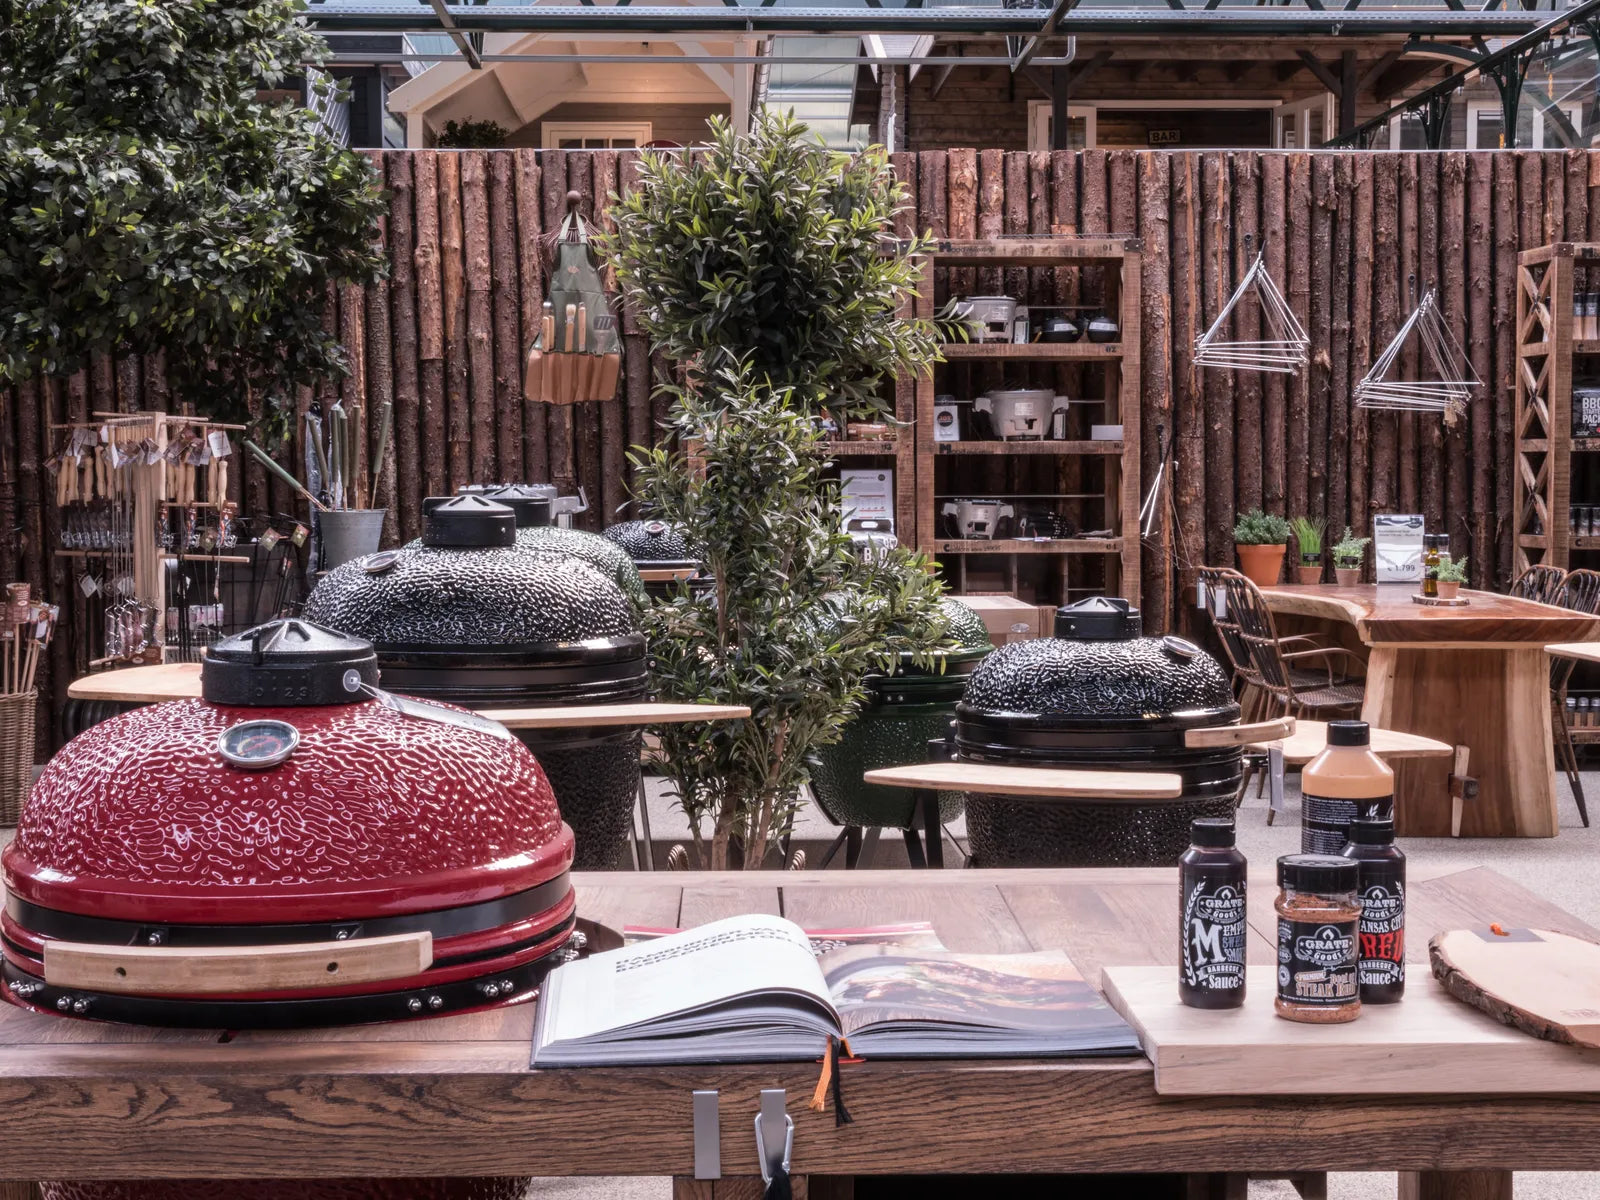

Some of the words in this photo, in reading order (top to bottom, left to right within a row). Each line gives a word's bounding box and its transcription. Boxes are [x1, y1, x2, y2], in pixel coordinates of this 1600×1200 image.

[1152, 131, 1177, 141] BAR
[1205, 899, 1243, 908] GRATE
[1213, 910, 1238, 919] Goods
[1364, 909, 1390, 918] Goods
[1360, 920, 1390, 934] ANSAS
[616, 929, 741, 965] HAMBURGER
[749, 926, 788, 935] VAN
[1305, 939, 1349, 950] GRATE
[1314, 952, 1342, 961] Goods
[1209, 974, 1239, 988] Sauce
[1360, 971, 1391, 985] Sauce
[1296, 982, 1335, 997] STEAK
